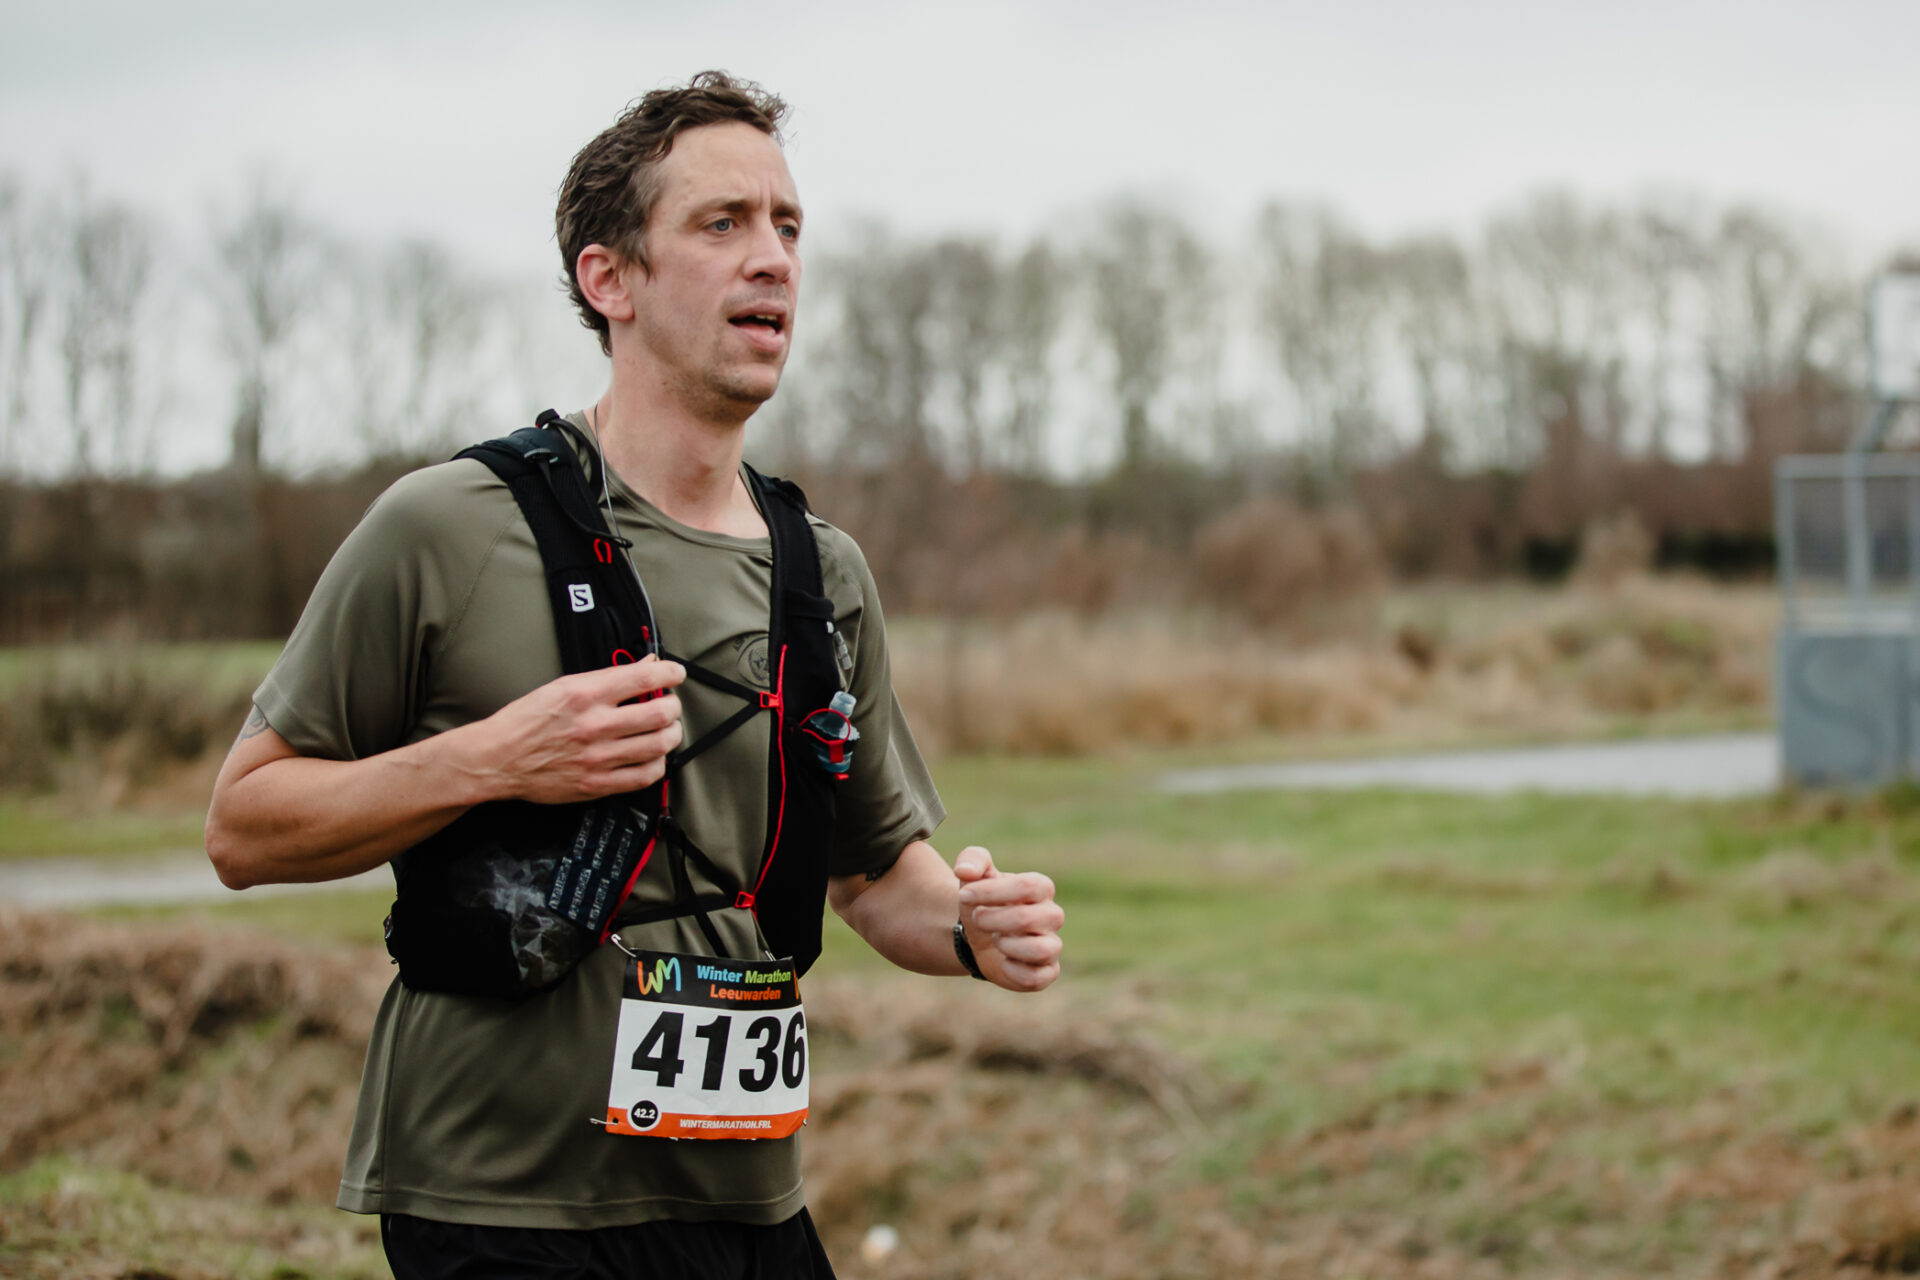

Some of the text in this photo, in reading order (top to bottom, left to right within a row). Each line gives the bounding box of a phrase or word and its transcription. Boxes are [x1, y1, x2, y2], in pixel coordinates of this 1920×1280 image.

[573, 588, 589, 608] S
[696, 965, 743, 983] Winter
[745, 969, 791, 984] Marathon
[709, 984, 781, 1001] Leeuwarden
[631, 1010, 806, 1093] 4136
[633, 1108, 656, 1119] 42.2
[679, 1118, 772, 1129] WINTERMARATHON.FRL
